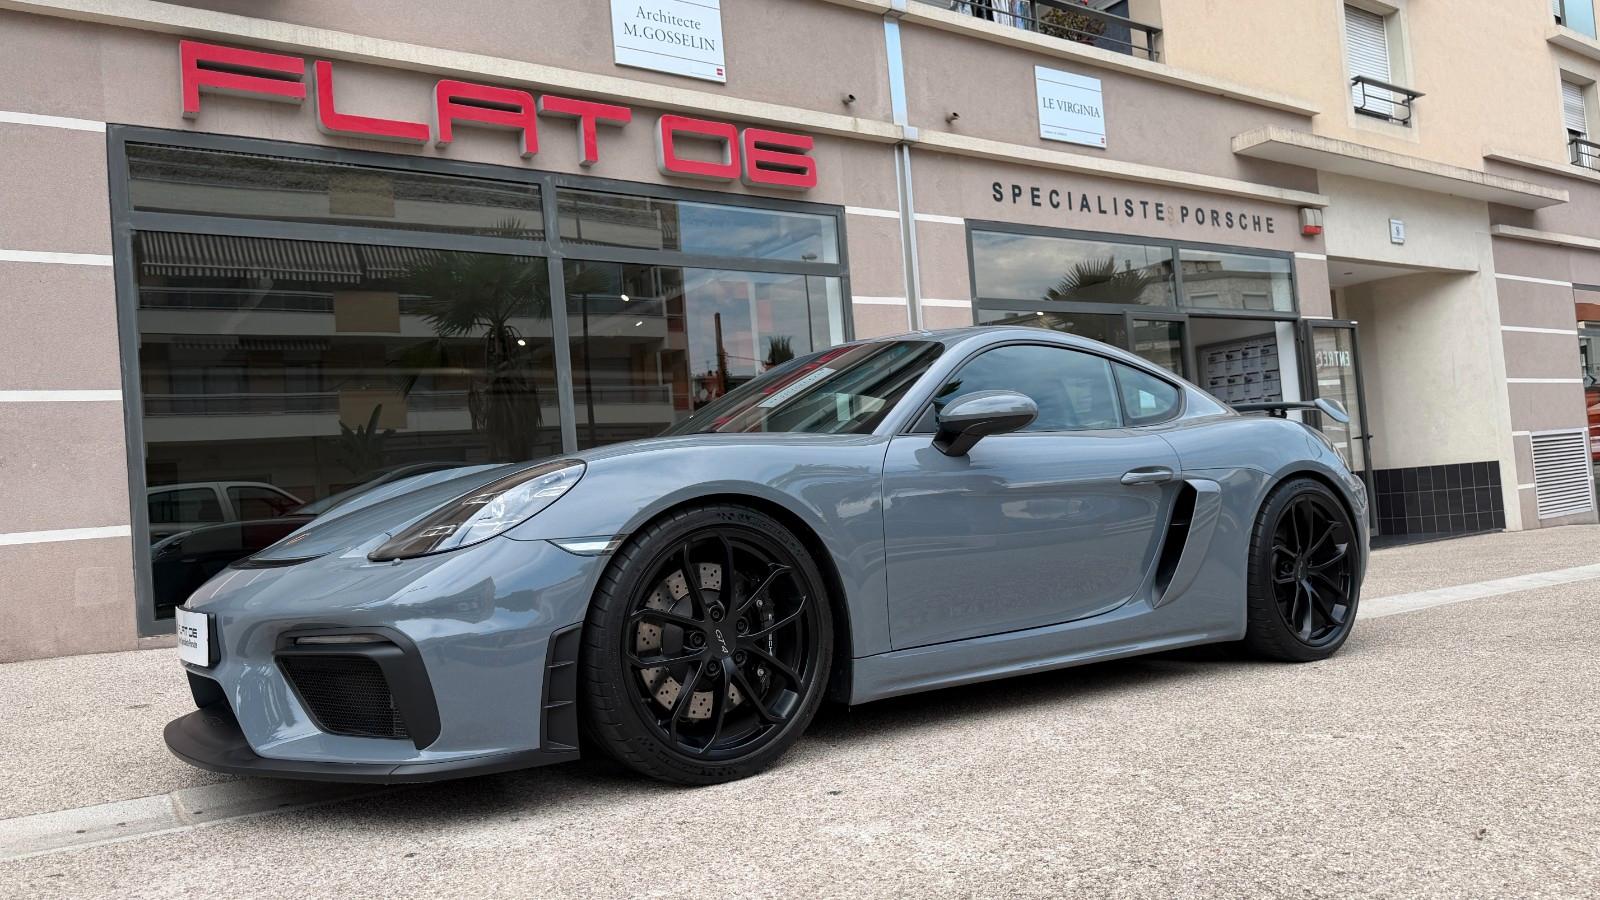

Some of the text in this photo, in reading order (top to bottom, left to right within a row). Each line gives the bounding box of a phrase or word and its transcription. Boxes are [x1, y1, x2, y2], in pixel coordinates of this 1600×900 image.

[636, 6, 701, 30] Architecte
[624, 22, 715, 51] M.GOSSELIN
[179, 40, 819, 190] FLAT 06
[1042, 97, 1101, 118] LE VIRGINIA
[1180, 206, 1276, 234] PORSCHE
